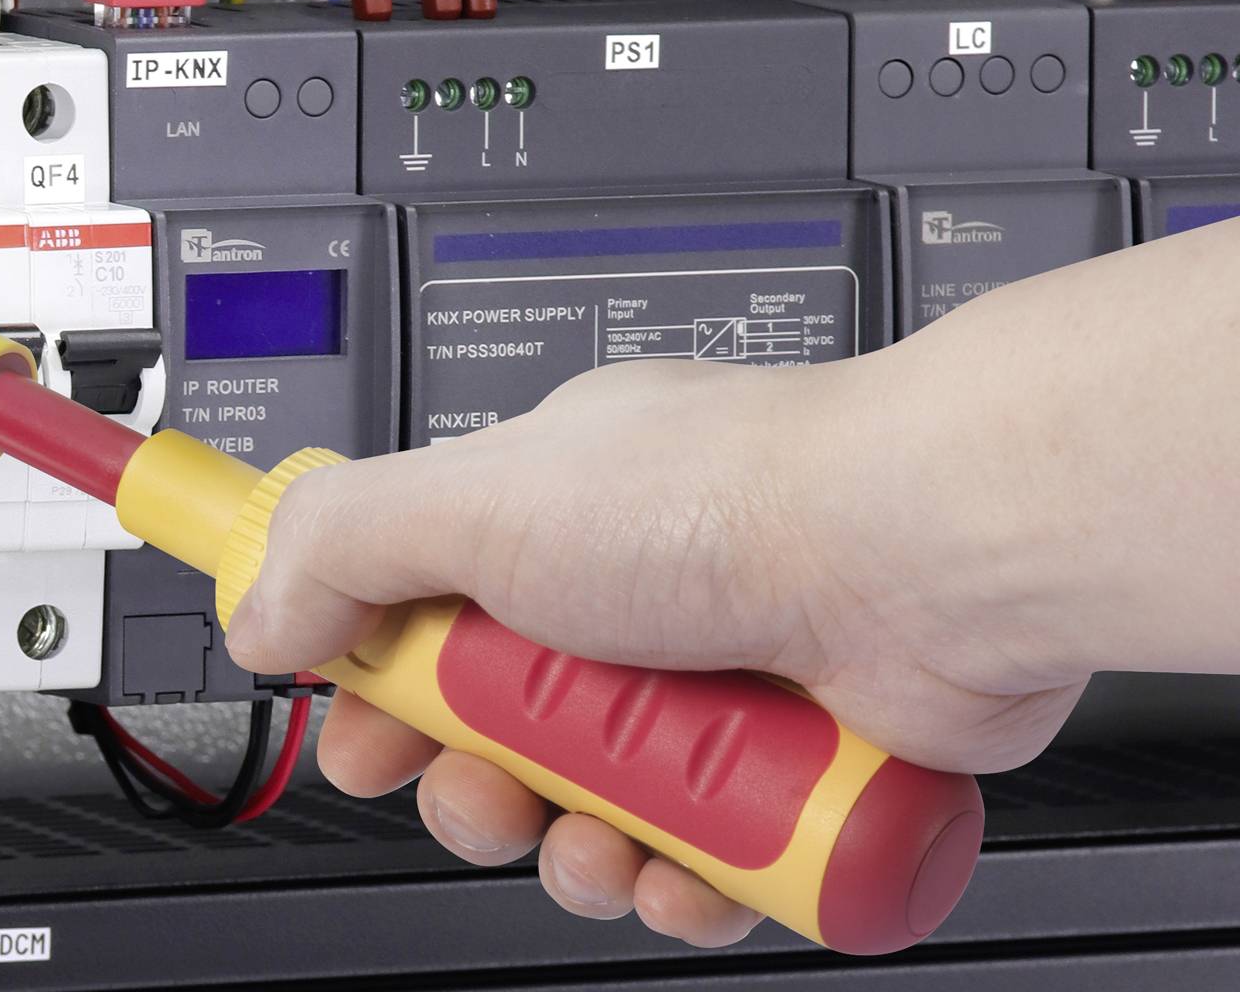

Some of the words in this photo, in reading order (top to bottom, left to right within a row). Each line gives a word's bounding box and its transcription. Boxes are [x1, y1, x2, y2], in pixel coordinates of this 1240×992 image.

[956, 28, 986, 49] LC
[611, 41, 655, 63] PS1
[132, 58, 222, 81] IP-KNX
[167, 122, 200, 138] LAN
[1210, 127, 1218, 141] L
[482, 152, 491, 167] L
[516, 151, 527, 166] N
[30, 163, 79, 188] QF4
[39, 229, 81, 248] ABB
[750, 293, 806, 304] Secondary
[921, 284, 956, 297] LINE
[608, 298, 648, 309] Primary
[750, 304, 785, 315] Output
[427, 311, 459, 326] KNX
[462, 309, 521, 324] POWER
[524, 306, 585, 322] SUPPLY
[608, 309, 634, 320] Input
[427, 345, 453, 360] T/N
[457, 342, 544, 358] PSS30640T
[606, 344, 641, 354] 50/60Hz
[183, 381, 199, 396] IP
[207, 379, 279, 395] ROUTER
[183, 408, 210, 423] T/N
[218, 406, 266, 421] IPR03
[428, 411, 499, 429] KNX/EIB
[204, 437, 254, 452] X/EIB
[0, 933, 45, 955] DCM
